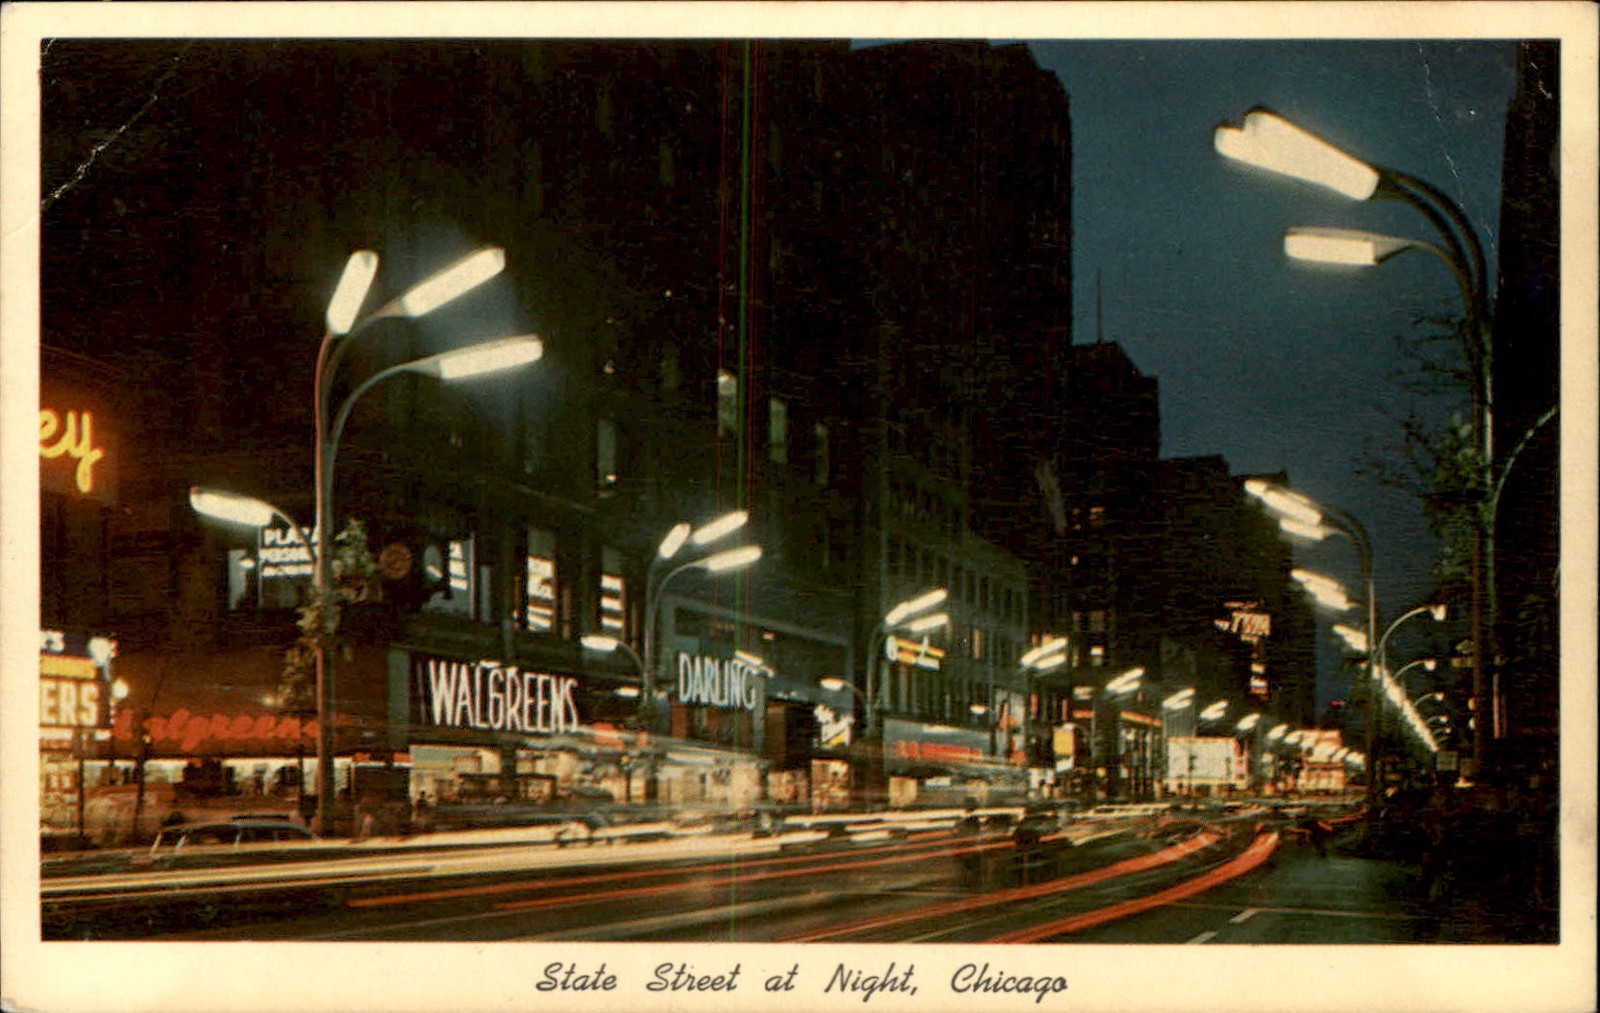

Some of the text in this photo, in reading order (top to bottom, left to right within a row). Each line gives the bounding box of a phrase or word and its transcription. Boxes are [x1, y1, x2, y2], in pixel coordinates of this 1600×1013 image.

[40, 409, 103, 493] ey
[40, 679, 99, 726] ERS
[428, 658, 579, 733] WALGREENS
[678, 652, 757, 710] DARLING
